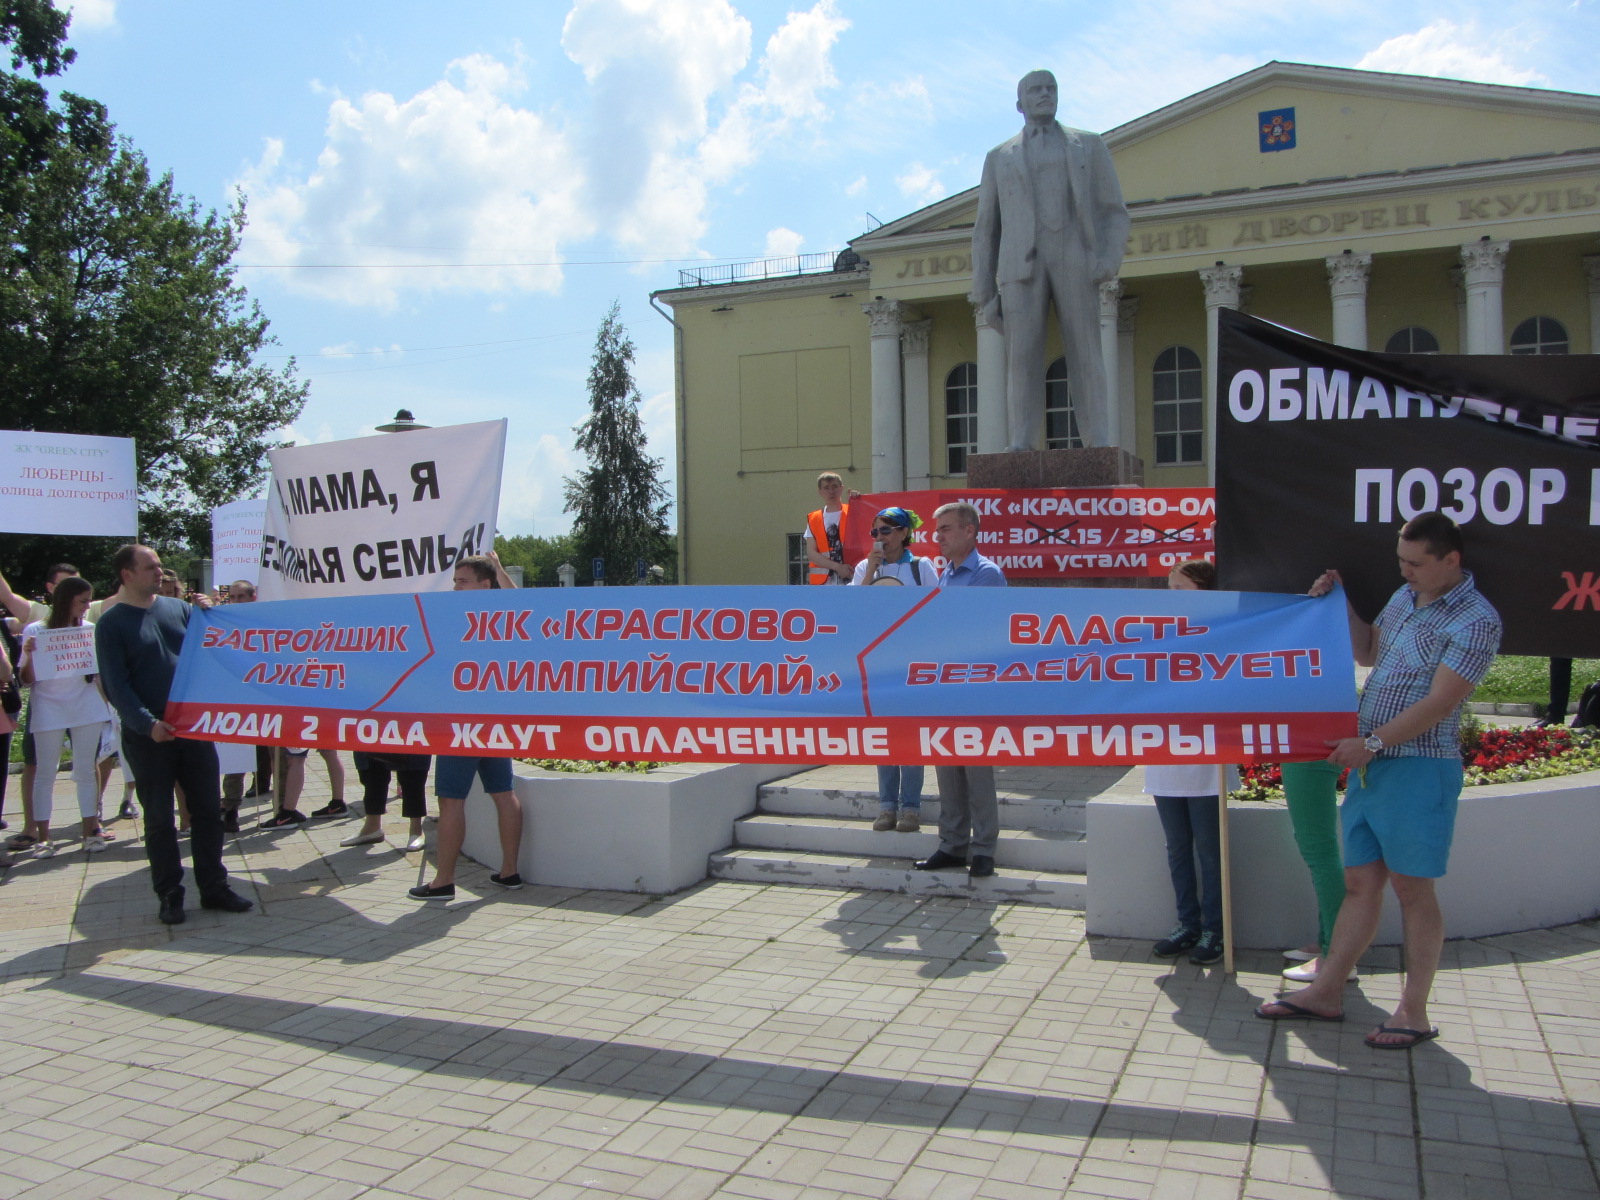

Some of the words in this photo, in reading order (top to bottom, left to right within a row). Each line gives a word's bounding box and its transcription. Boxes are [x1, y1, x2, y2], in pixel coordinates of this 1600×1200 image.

[896, 254, 972, 279] ЛЮ
[1233, 203, 1431, 246] ДВОРЕЦ
[20, 466, 105, 483] ЛЮБЕРЦЫ
[287, 468, 398, 515] МАМА,
[410, 461, 440, 502] Я
[0, 486, 43, 498] олица
[47, 489, 137, 502] долгостроя!!!
[958, 497, 1002, 516] ЖК
[1354, 467, 1567, 526] ПОЗОР
[353, 522, 485, 582] СЕМЬЯ!
[1053, 553, 1147, 573] устали
[49, 632, 93, 642] СЕГОДНЯ
[202, 622, 410, 653] ЗАСТРОЙЩИК
[461, 610, 533, 642] ЖК
[540, 608, 838, 642] «КРАСКОВО-
[1008, 613, 1210, 647] ВЛАСТЬ
[53, 651, 92, 661] ЗАВТРА
[55, 660, 93, 671] БОМЖ!
[906, 648, 1322, 686] БЕЗДЕЙСТВУЕТ!
[242, 658, 346, 689] ЛЖЁТ!
[452, 653, 842, 696] ОЛИМПИЙСКИЙ»
[190, 711, 283, 738] ЛЮДИ
[300, 716, 319, 741] 2
[338, 718, 430, 747] ГОДА
[450, 722, 560, 751] ЖДУТ
[584, 726, 890, 757] ОПЛАЧЕННЫЕ
[919, 724, 1217, 757] КВАРТИРЫ
[1241, 724, 1290, 754] !!!
